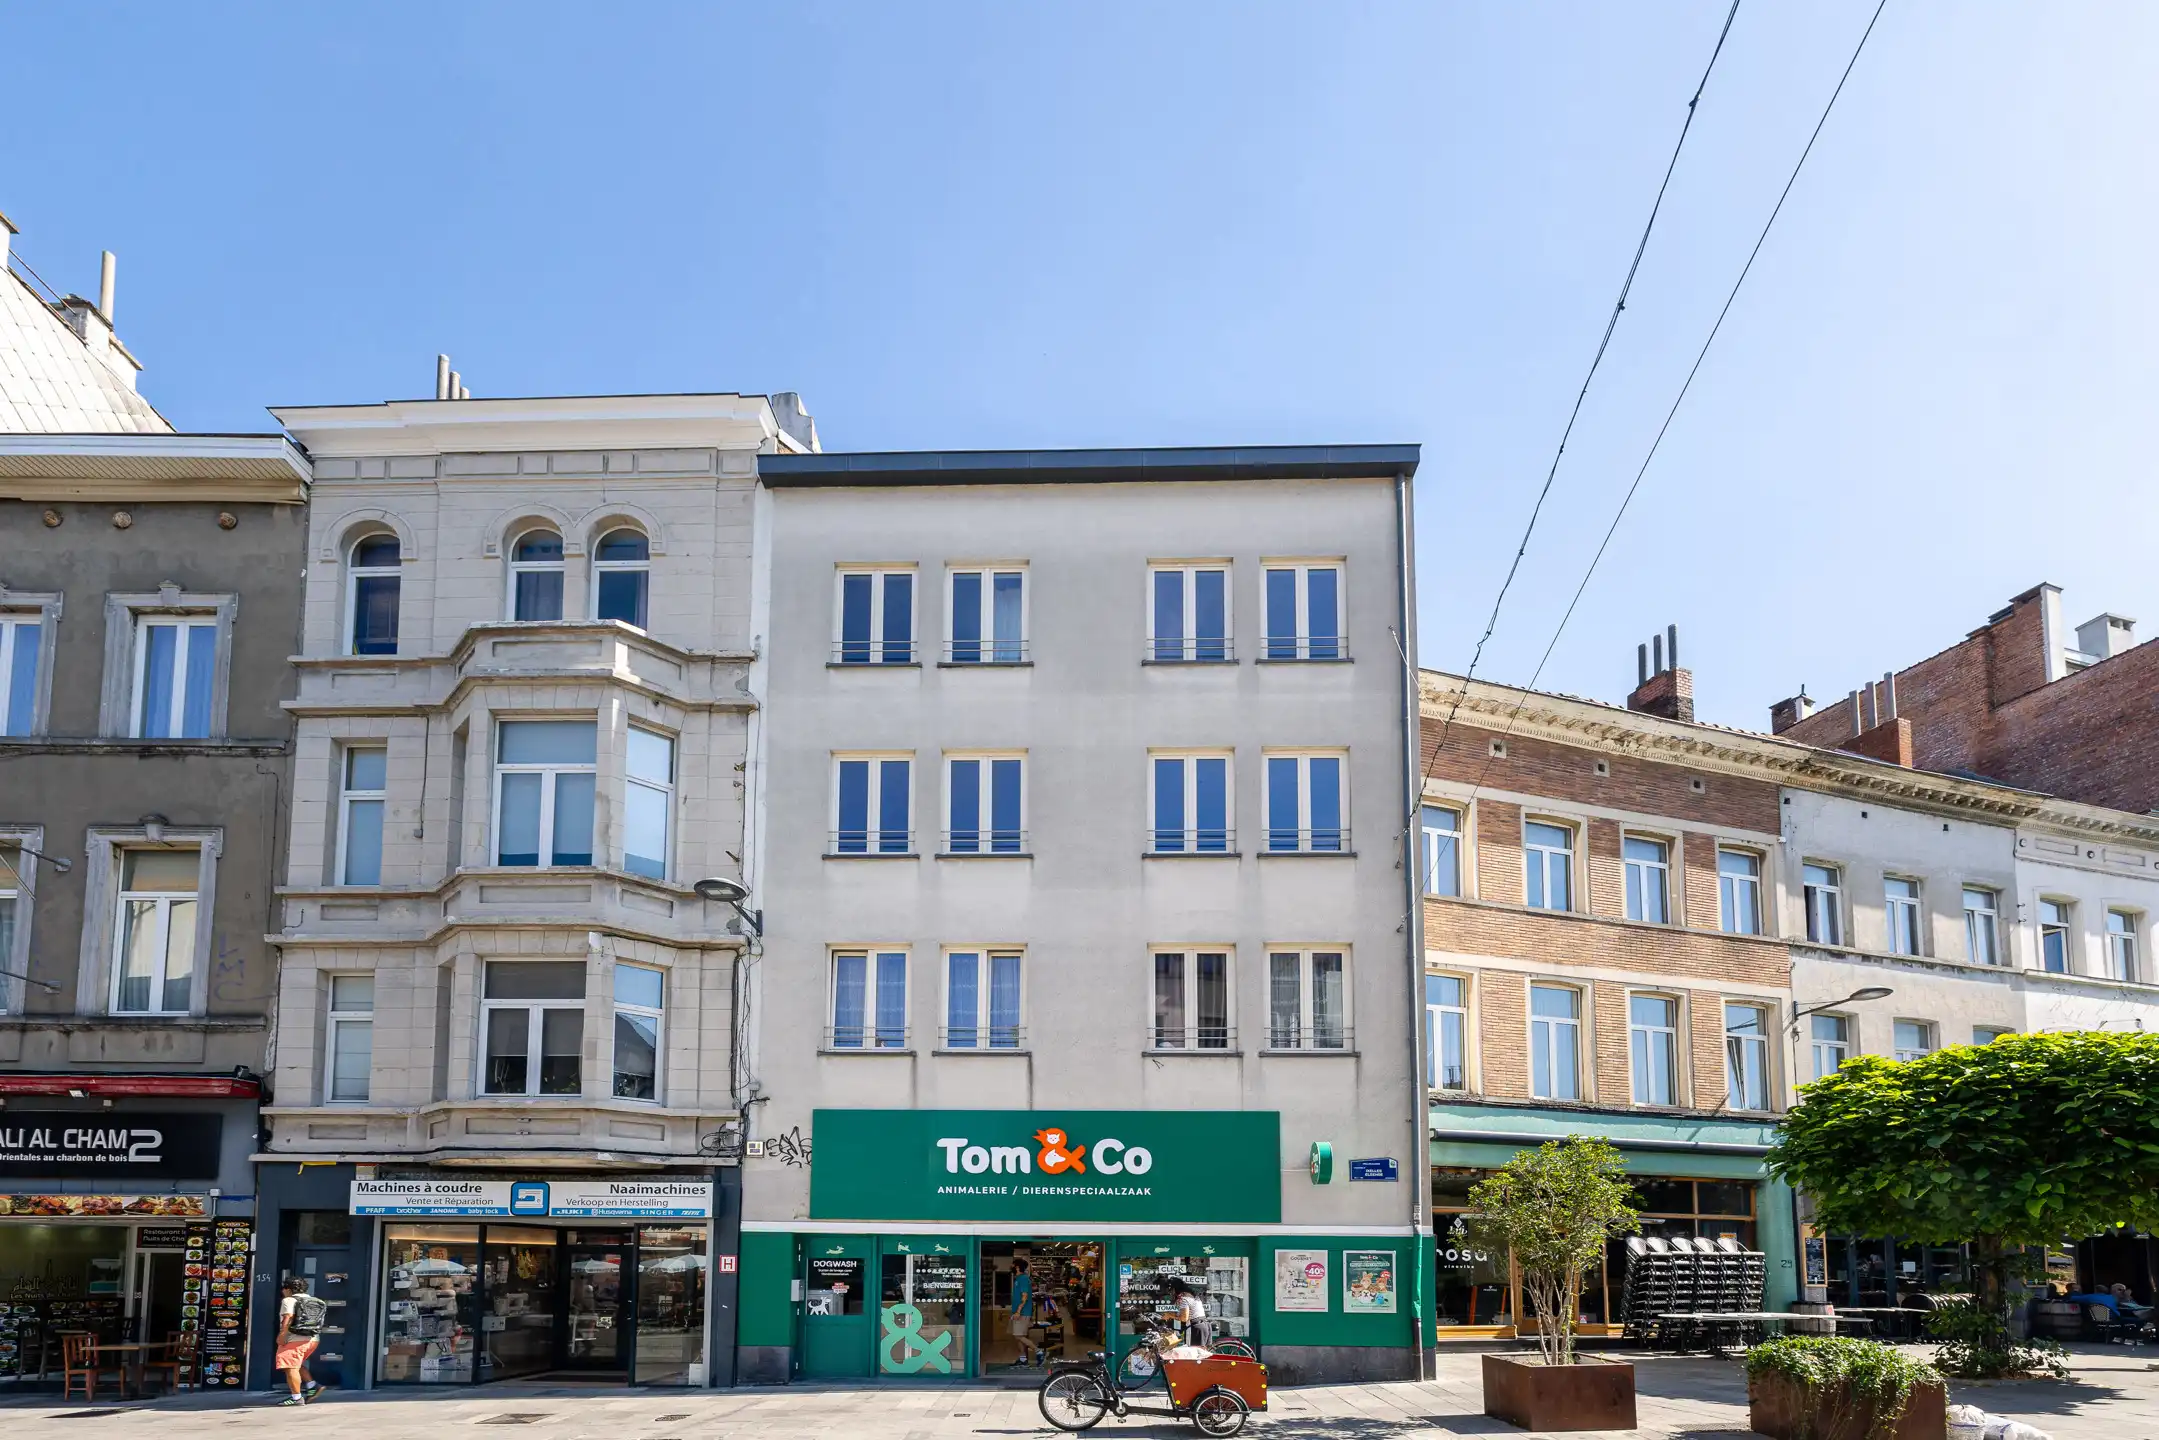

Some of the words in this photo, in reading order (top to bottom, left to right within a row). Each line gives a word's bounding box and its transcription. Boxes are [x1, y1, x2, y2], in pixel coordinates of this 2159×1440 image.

[29, 1128, 58, 1148] AL
[64, 1129, 128, 1148] CHAM
[129, 1130, 162, 1162] 2
[56, 1154, 93, 1162] charbon
[95, 1154, 106, 1162] de
[108, 1154, 128, 1162] bois
[936, 1138, 1031, 1174] Tom
[1092, 1138, 1152, 1175] Co
[356, 1182, 420, 1193] Machines
[424, 1182, 432, 1193] à
[436, 1182, 482, 1194] coudre
[610, 1184, 706, 1195] Naaimachines
[937, 1186, 1008, 1195] ANIMALERIE
[1012, 1185, 1018, 1195] /
[1022, 1186, 1152, 1196] DIERENSPECIAALZAAK
[406, 1197, 432, 1205] Vente
[445, 1196, 494, 1207] Réparation
[566, 1198, 604, 1207] Verkoop
[620, 1198, 668, 1208] Herstelling
